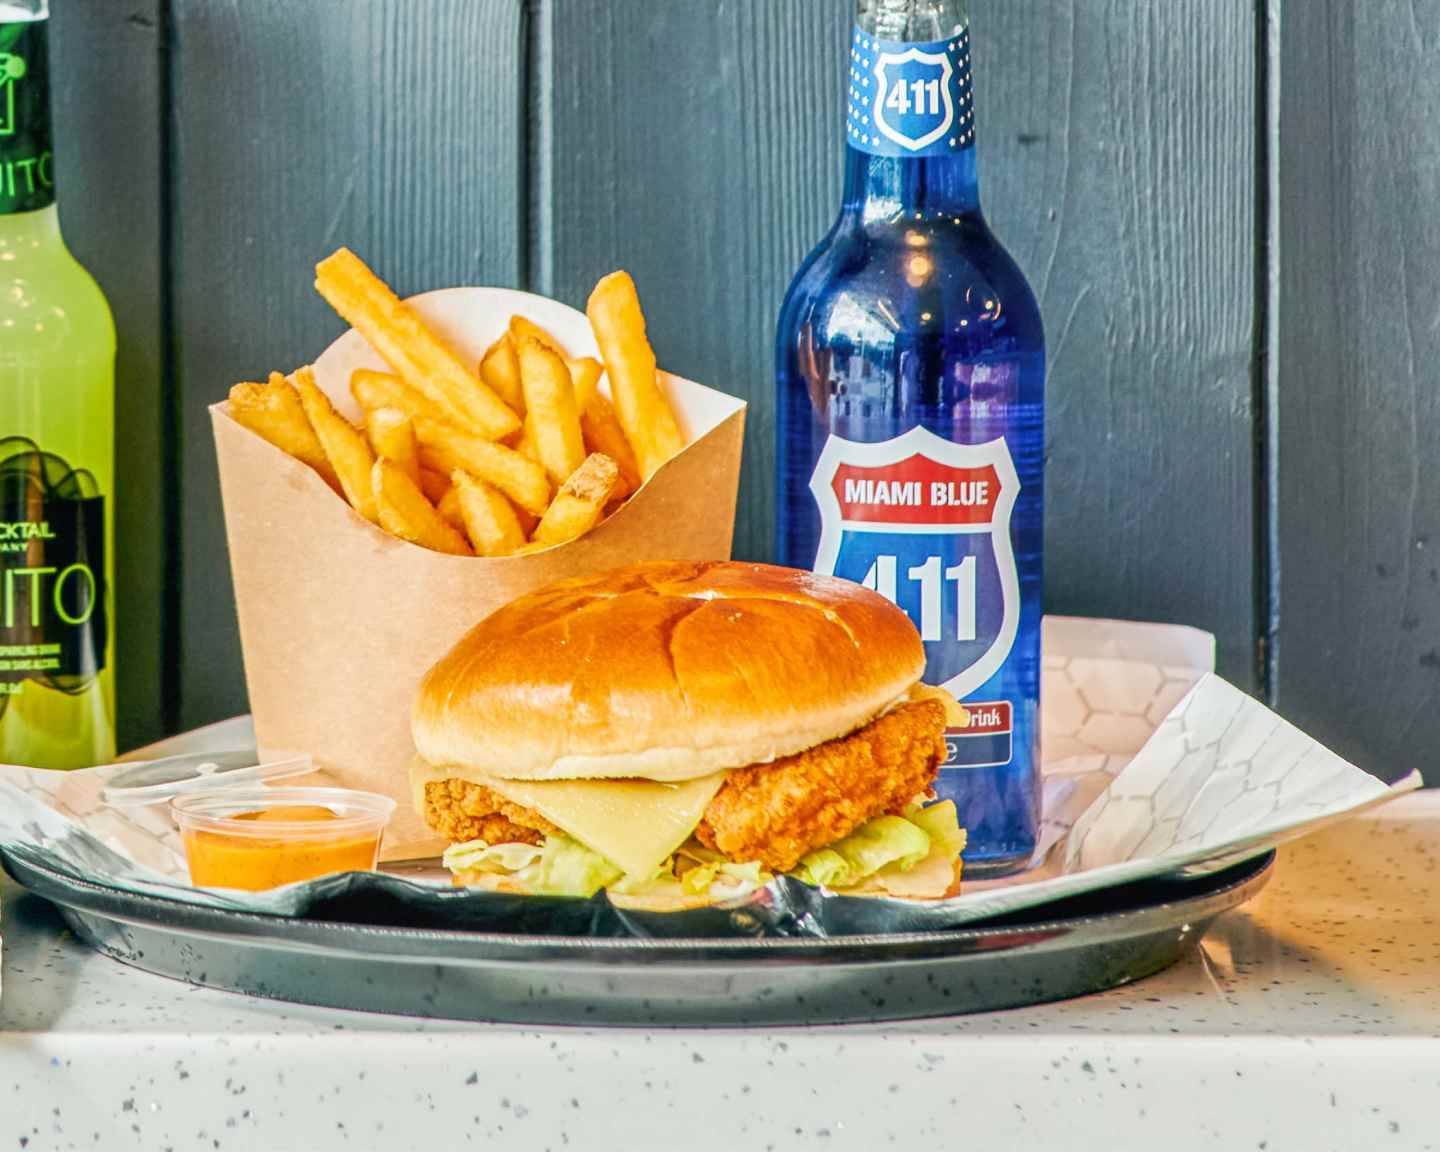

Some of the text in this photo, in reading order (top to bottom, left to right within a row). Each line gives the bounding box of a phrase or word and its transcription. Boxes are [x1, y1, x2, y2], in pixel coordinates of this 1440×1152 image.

[886, 79, 940, 115] 411
[845, 479, 989, 506] MIAMI BLUE
[969, 707, 1002, 727] rink
